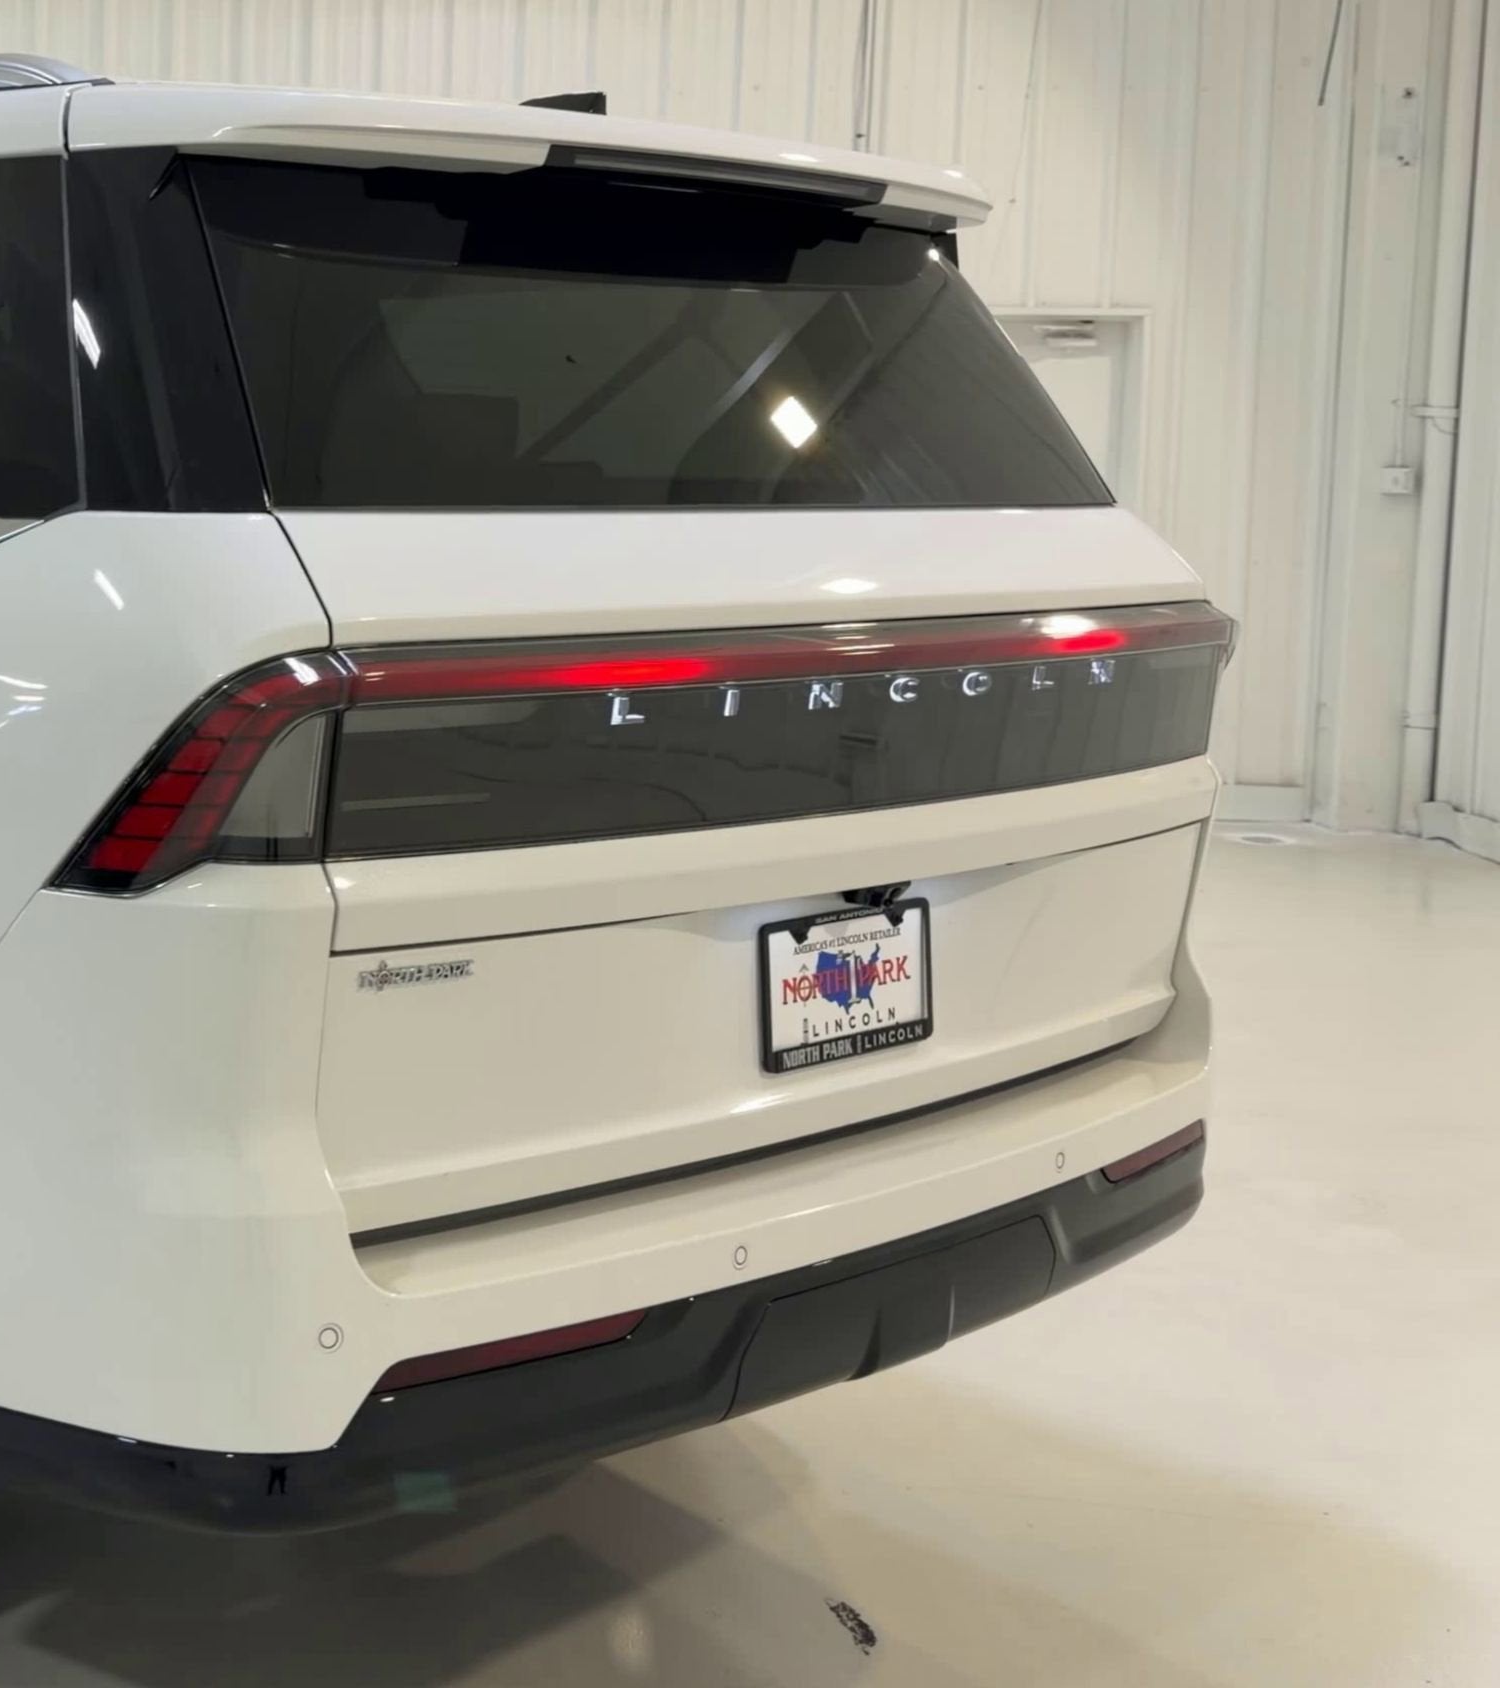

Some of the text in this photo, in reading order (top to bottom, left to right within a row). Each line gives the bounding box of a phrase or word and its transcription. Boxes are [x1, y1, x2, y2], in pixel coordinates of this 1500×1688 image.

[609, 657, 1116, 726] LINCOLN
[836, 932, 869, 947] LINCOLN
[869, 927, 901, 940] RETAILER
[782, 955, 911, 1005] NORTH PARK
[812, 1007, 896, 1037] LINCOLN
[782, 1024, 924, 1070] NORTH PARK LINCOLN
